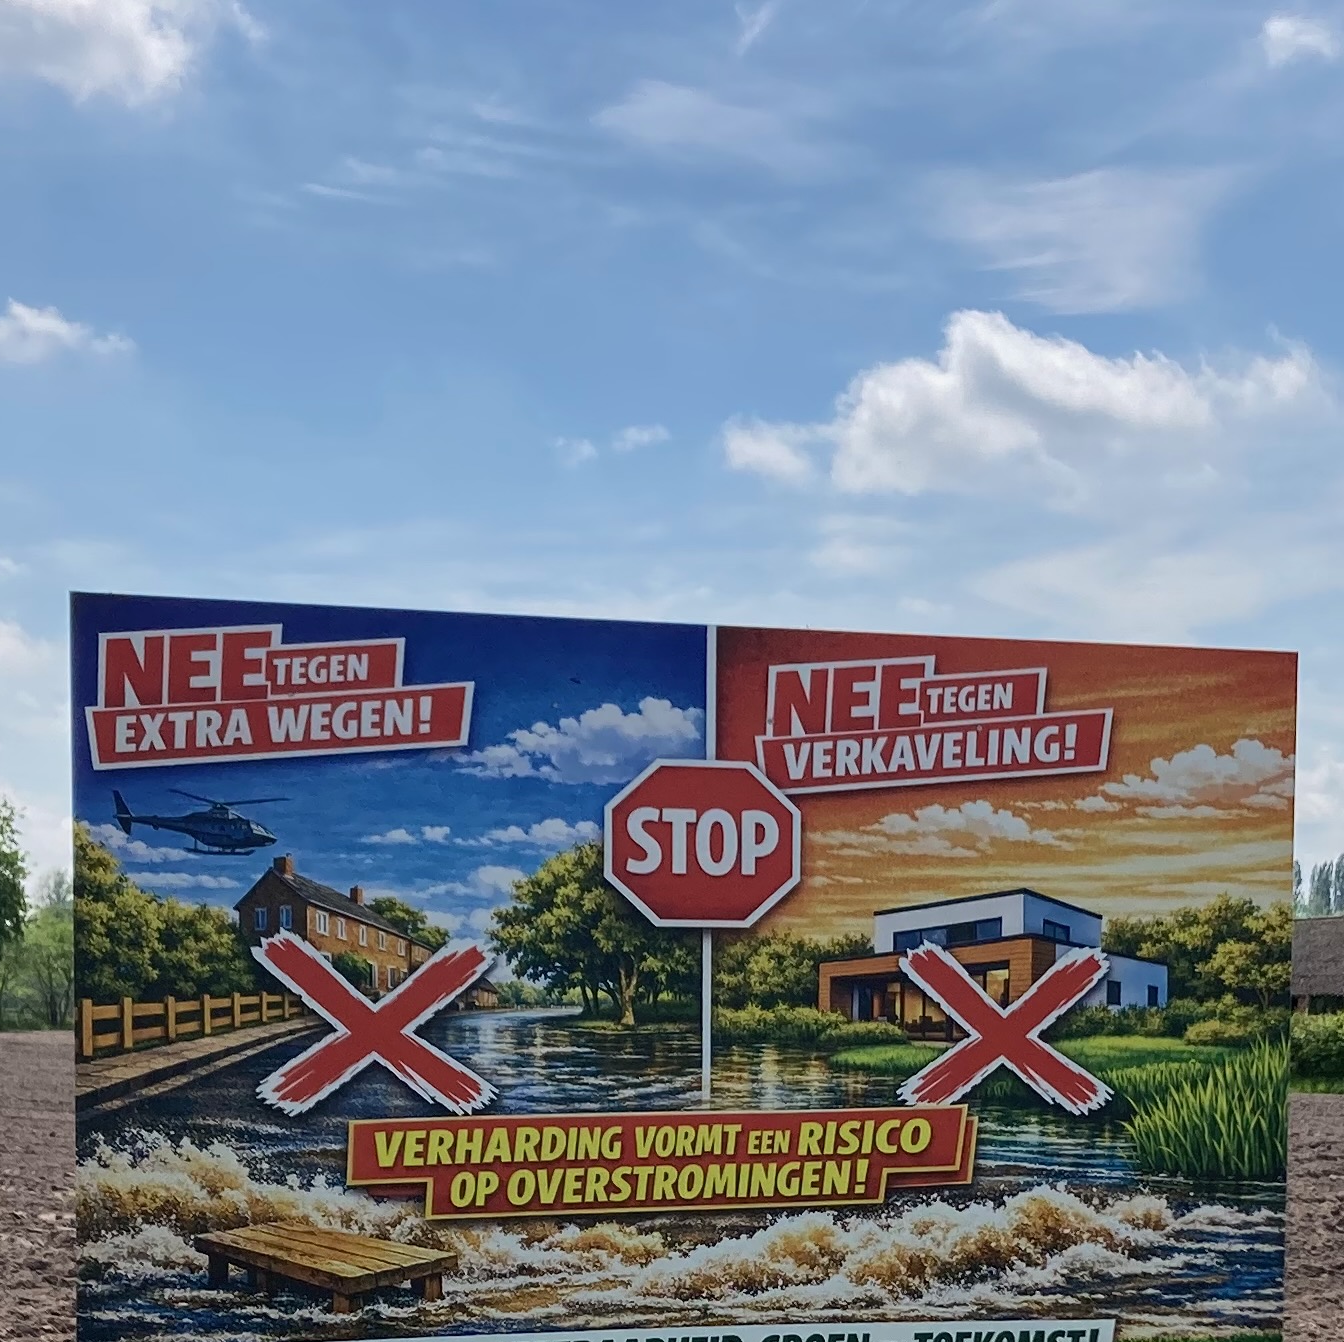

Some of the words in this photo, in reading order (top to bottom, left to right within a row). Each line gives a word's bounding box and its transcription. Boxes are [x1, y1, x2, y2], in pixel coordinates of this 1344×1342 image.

[105, 632, 273, 707] NEE
[273, 653, 369, 686] TEGEN
[114, 707, 254, 753] EXTRA
[267, 696, 433, 743] WEGEN!
[773, 663, 926, 737] NEE
[927, 683, 1013, 715] TEGEN
[783, 724, 1076, 781] VERKAVELING!
[625, 807, 780, 876] STOP
[373, 1126, 623, 1168] VERHARDING
[635, 1124, 742, 1159] VORMT
[747, 1129, 791, 1155] EEN
[797, 1117, 932, 1156] RISICO
[449, 1171, 499, 1208] OP
[506, 1159, 868, 1205] OVERSTROMINGEN!
